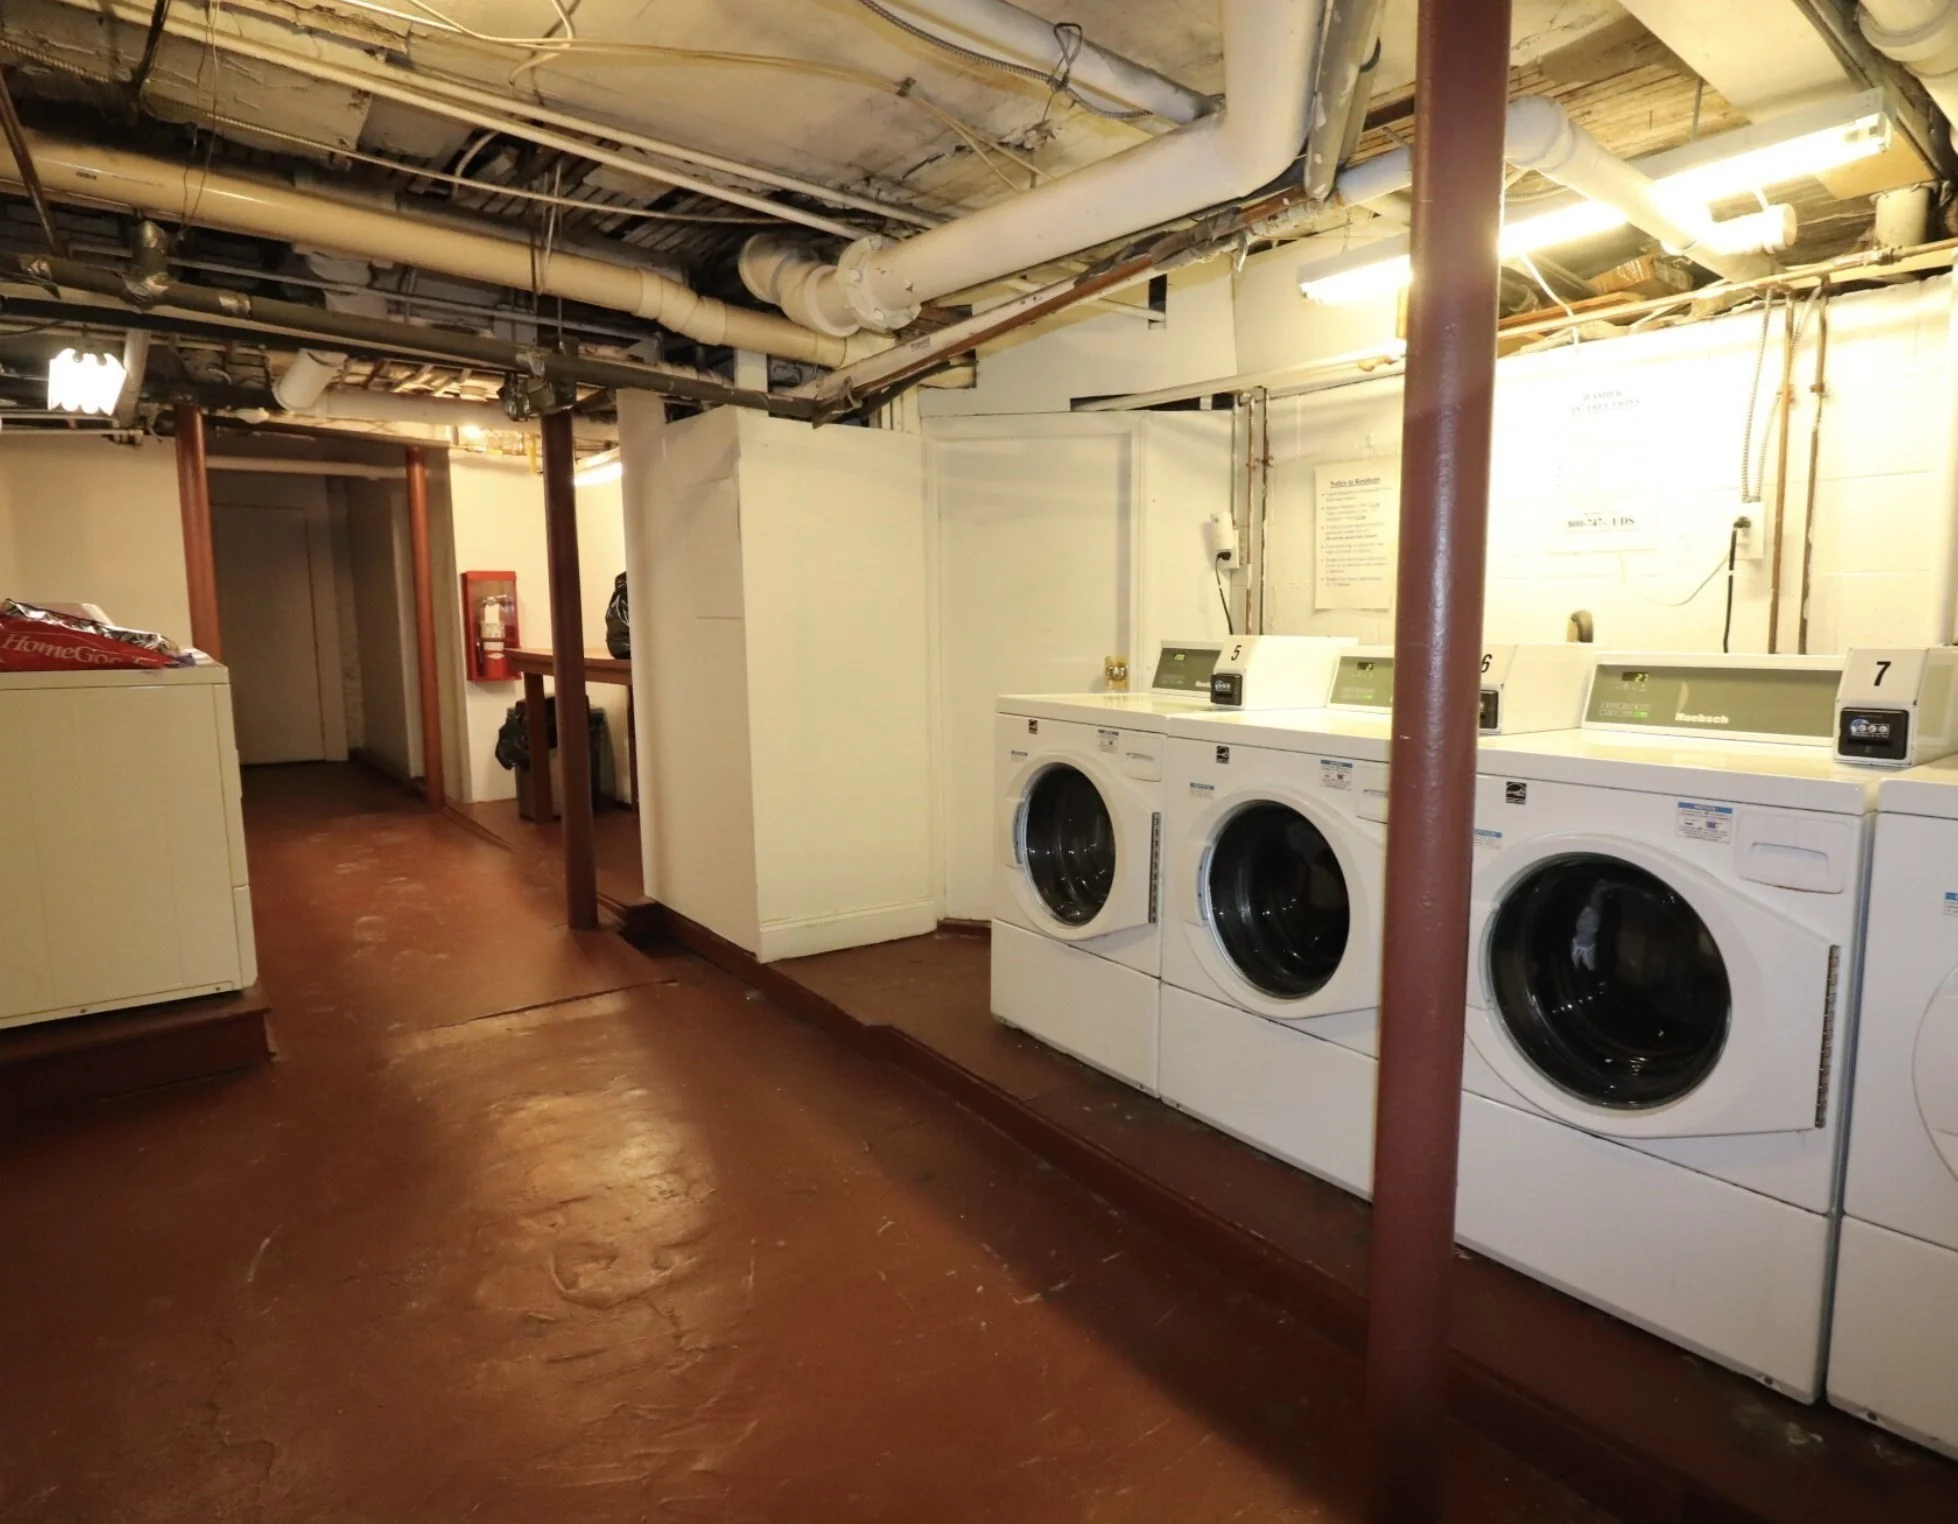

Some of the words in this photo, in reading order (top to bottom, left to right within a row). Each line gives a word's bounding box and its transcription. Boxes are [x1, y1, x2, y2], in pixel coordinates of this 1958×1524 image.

[1230, 644, 1242, 661] 5
[1481, 653, 1493, 674] 6
[1873, 661, 1892, 687] 7
[1675, 712, 1730, 725] Huebsch
